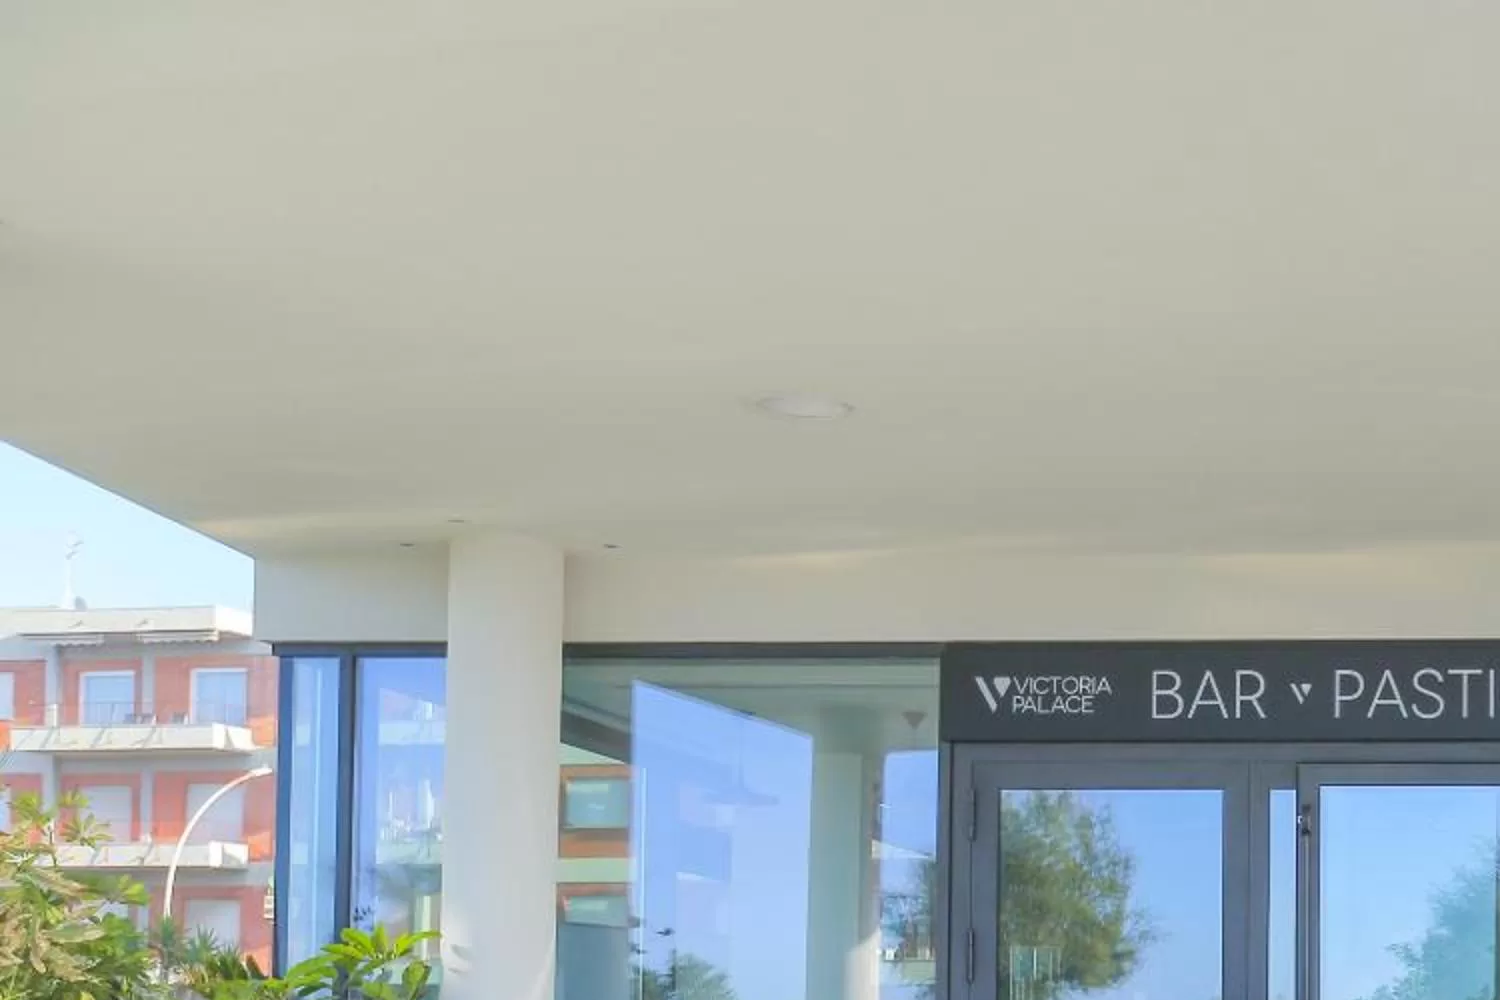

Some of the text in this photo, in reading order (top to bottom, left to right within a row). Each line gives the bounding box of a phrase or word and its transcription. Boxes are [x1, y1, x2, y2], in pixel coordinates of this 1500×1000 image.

[1013, 675, 1113, 695] VICTORIA
[1151, 669, 1267, 719] BAR
[1011, 695, 1096, 714] PALACE
